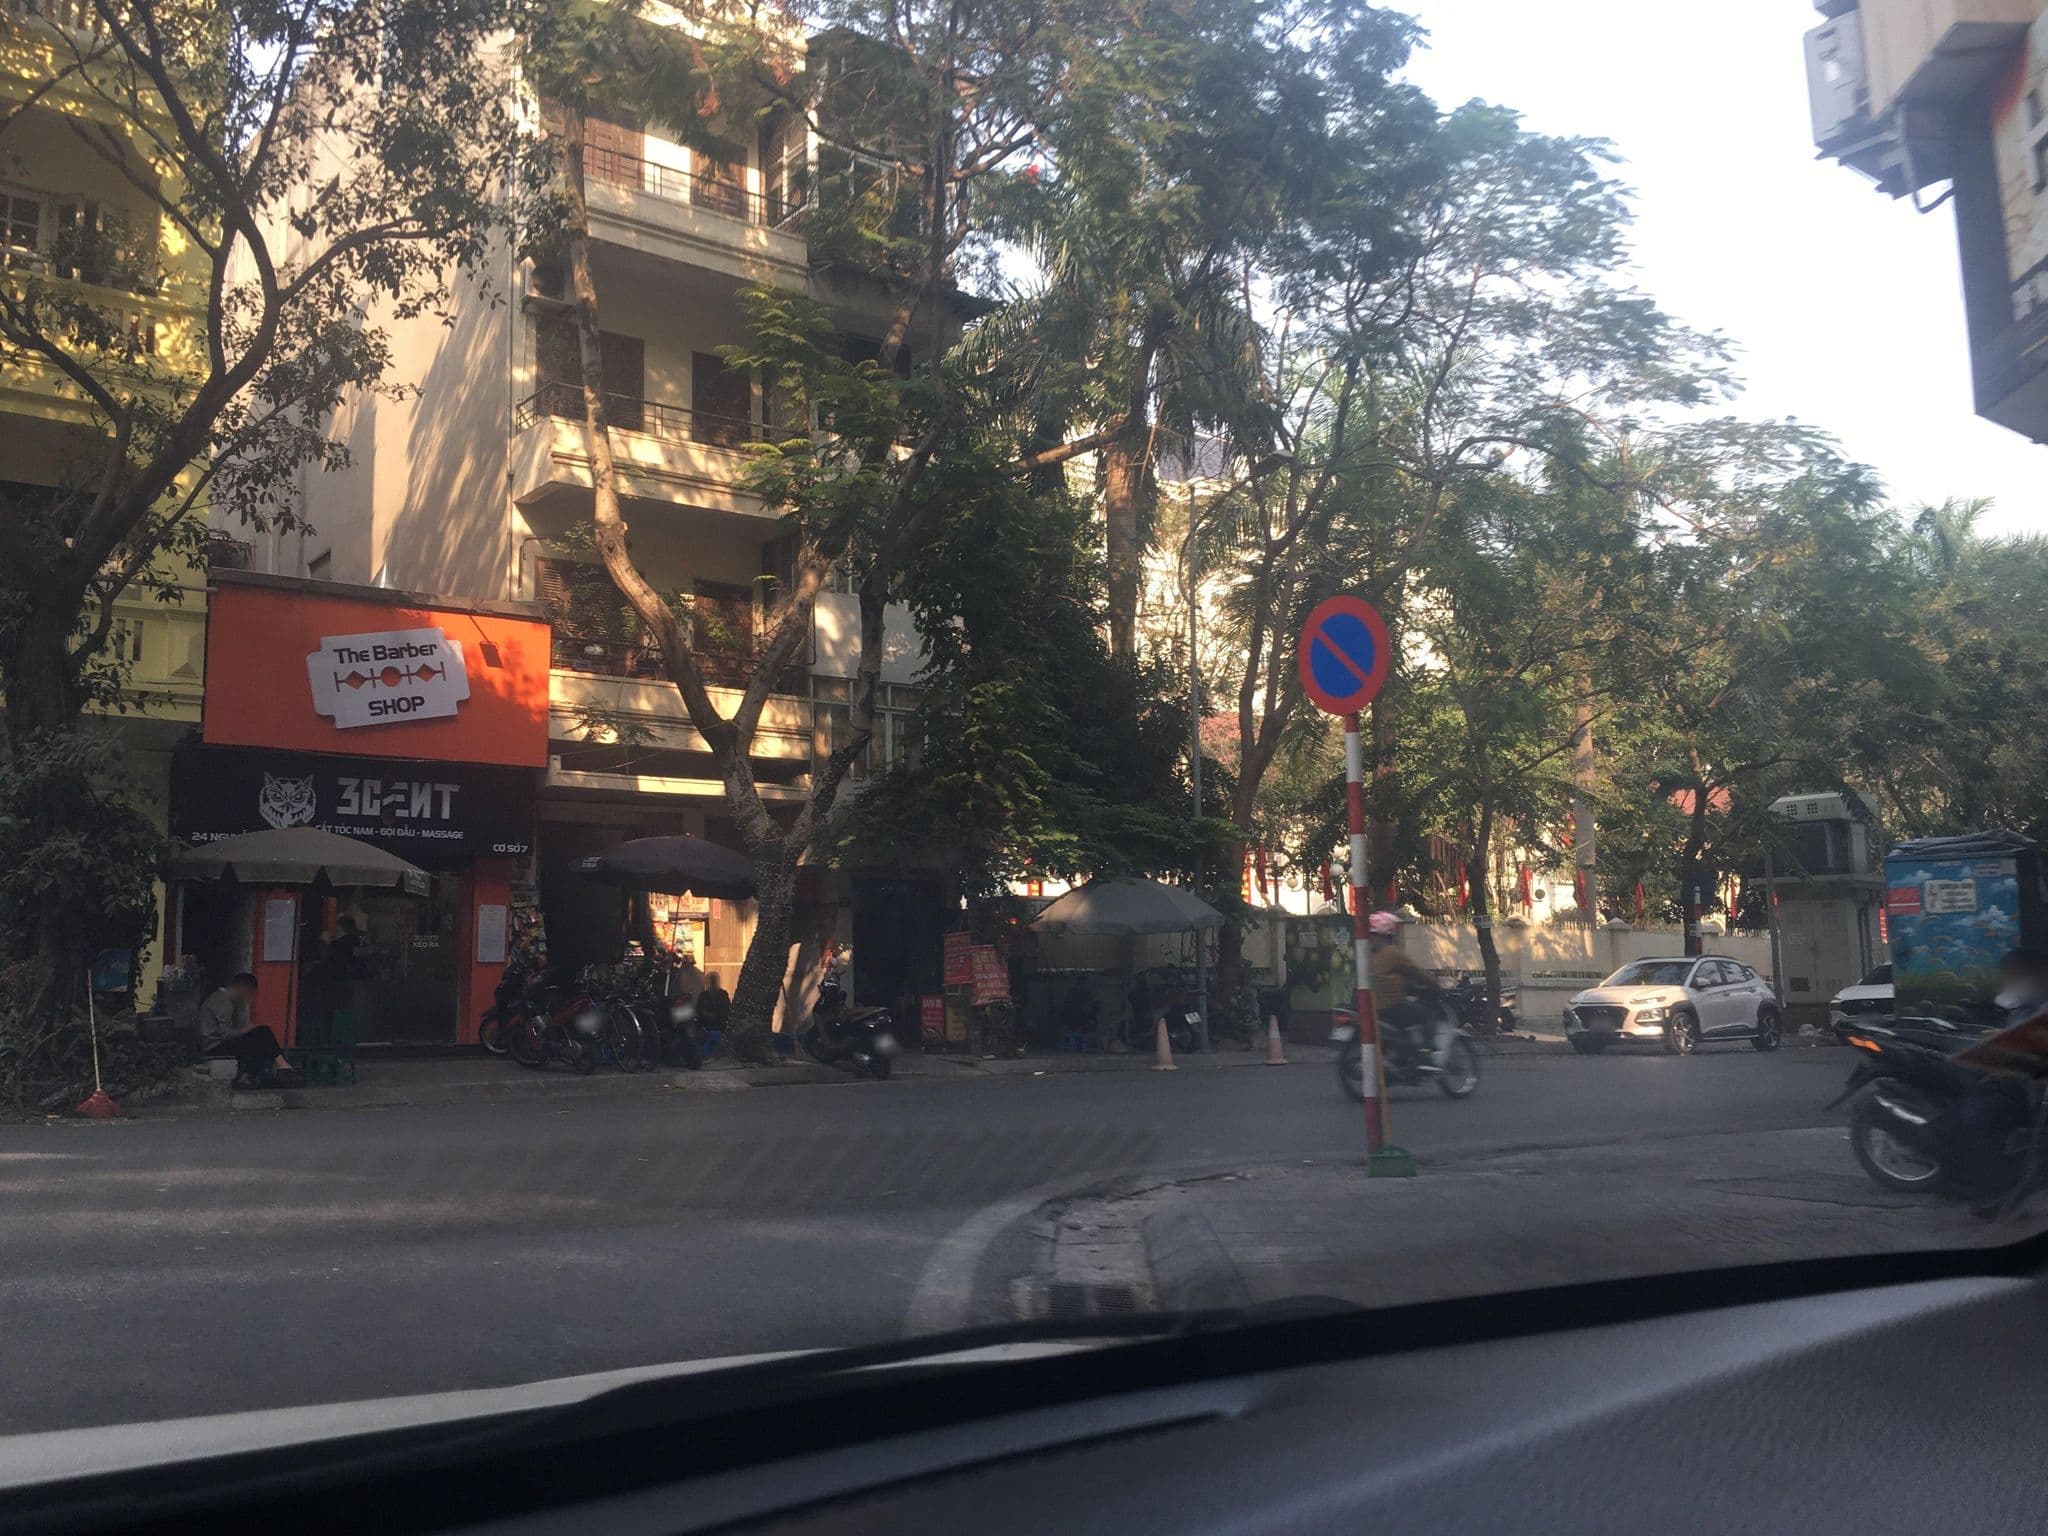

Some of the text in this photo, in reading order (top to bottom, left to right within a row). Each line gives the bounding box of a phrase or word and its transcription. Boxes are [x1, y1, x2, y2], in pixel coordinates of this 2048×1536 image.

[333, 643, 437, 664] The Barber
[368, 696, 425, 716] SHOP
[191, 832, 208, 841] 24
[334, 823, 352, 834] TÓC
[353, 826, 374, 836] NAM
[422, 829, 465, 840] MASSAGE
[521, 845, 529, 853] 7
